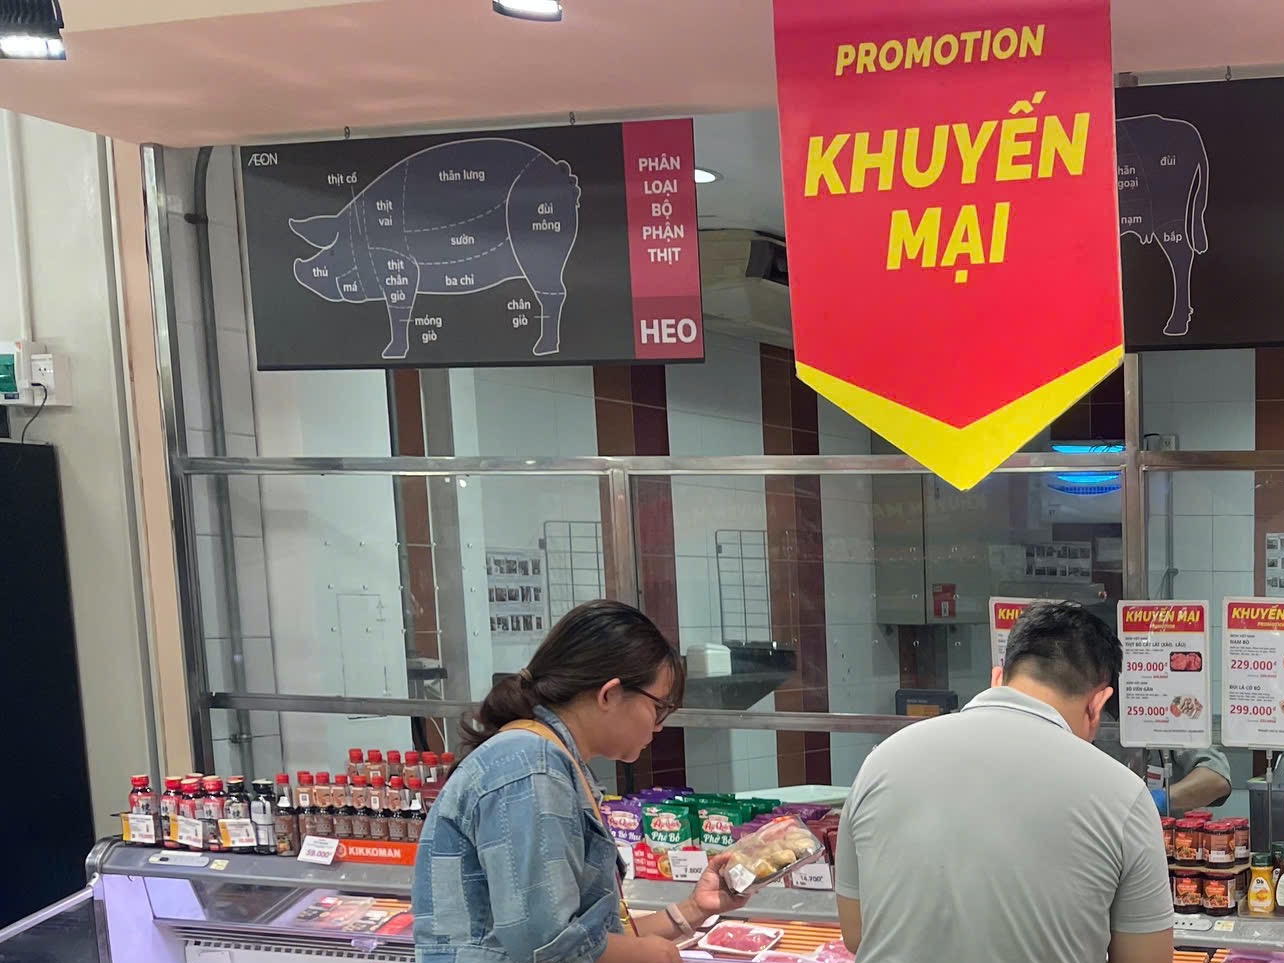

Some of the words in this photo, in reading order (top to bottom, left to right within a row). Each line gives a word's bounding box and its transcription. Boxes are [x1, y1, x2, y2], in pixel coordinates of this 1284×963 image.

[834, 24, 1045, 76] PROMOTION
[803, 90, 1090, 197] KHUYẾN
[638, 153, 681, 172] PHÂN
[1160, 155, 1177, 167] đùi
[328, 174, 344, 186] thịt
[463, 169, 485, 183] lưng
[643, 179, 678, 197] LOẠI
[1117, 177, 1139, 190] goại
[376, 200, 393, 212] thịt
[537, 203, 553, 216] đùi
[651, 199, 673, 219] BỘ
[378, 215, 393, 226] vai
[1121, 214, 1143, 226] nạm
[450, 234, 475, 246] sườn
[642, 224, 685, 243] PHẬN
[886, 201, 1011, 284] MẠI
[647, 247, 682, 265] THỊT
[387, 260, 404, 272] thịt
[343, 281, 358, 292] má
[445, 275, 459, 286] ba
[390, 289, 406, 302] giò
[507, 299, 531, 311] chân
[414, 315, 443, 328] móng
[512, 315, 528, 328] giò
[421, 330, 438, 343] giò
[640, 318, 697, 344] HEO
[1126, 606, 1175, 622] KHUYẾN
[1177, 609, 1201, 624] MẠI
[349, 846, 401, 858] KIKKOMAN
